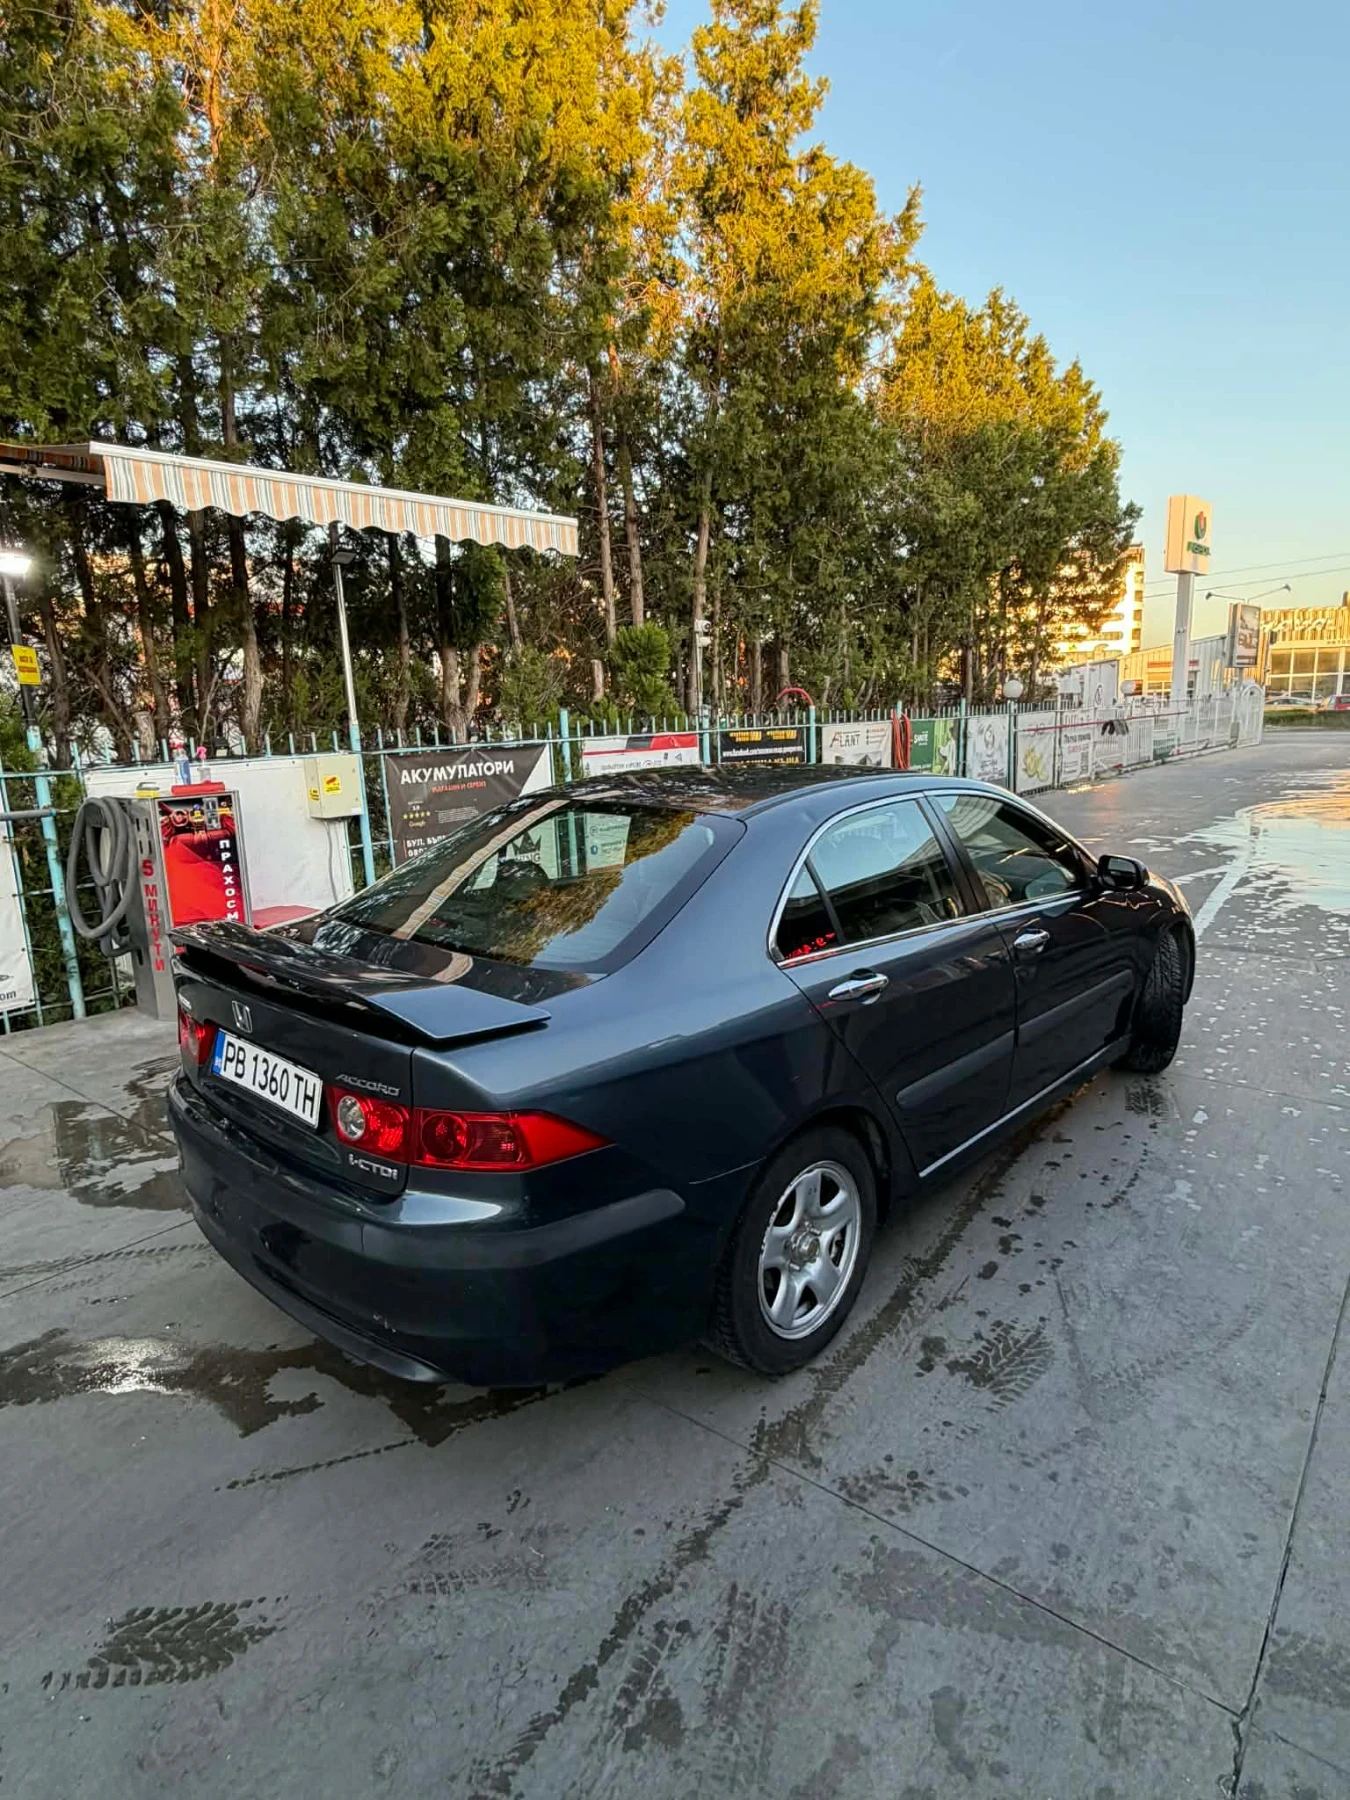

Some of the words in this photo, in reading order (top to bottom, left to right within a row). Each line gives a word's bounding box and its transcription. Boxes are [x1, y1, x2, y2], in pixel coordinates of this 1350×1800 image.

[401, 760, 514, 785] АКУМУЛАТОРИ
[142, 860, 154, 876] 5
[144, 884, 165, 971] МИНУТИ
[252, 1053, 290, 1101] 1360
[294, 1073, 317, 1119] TH
[335, 1073, 400, 1097] ACCORD
